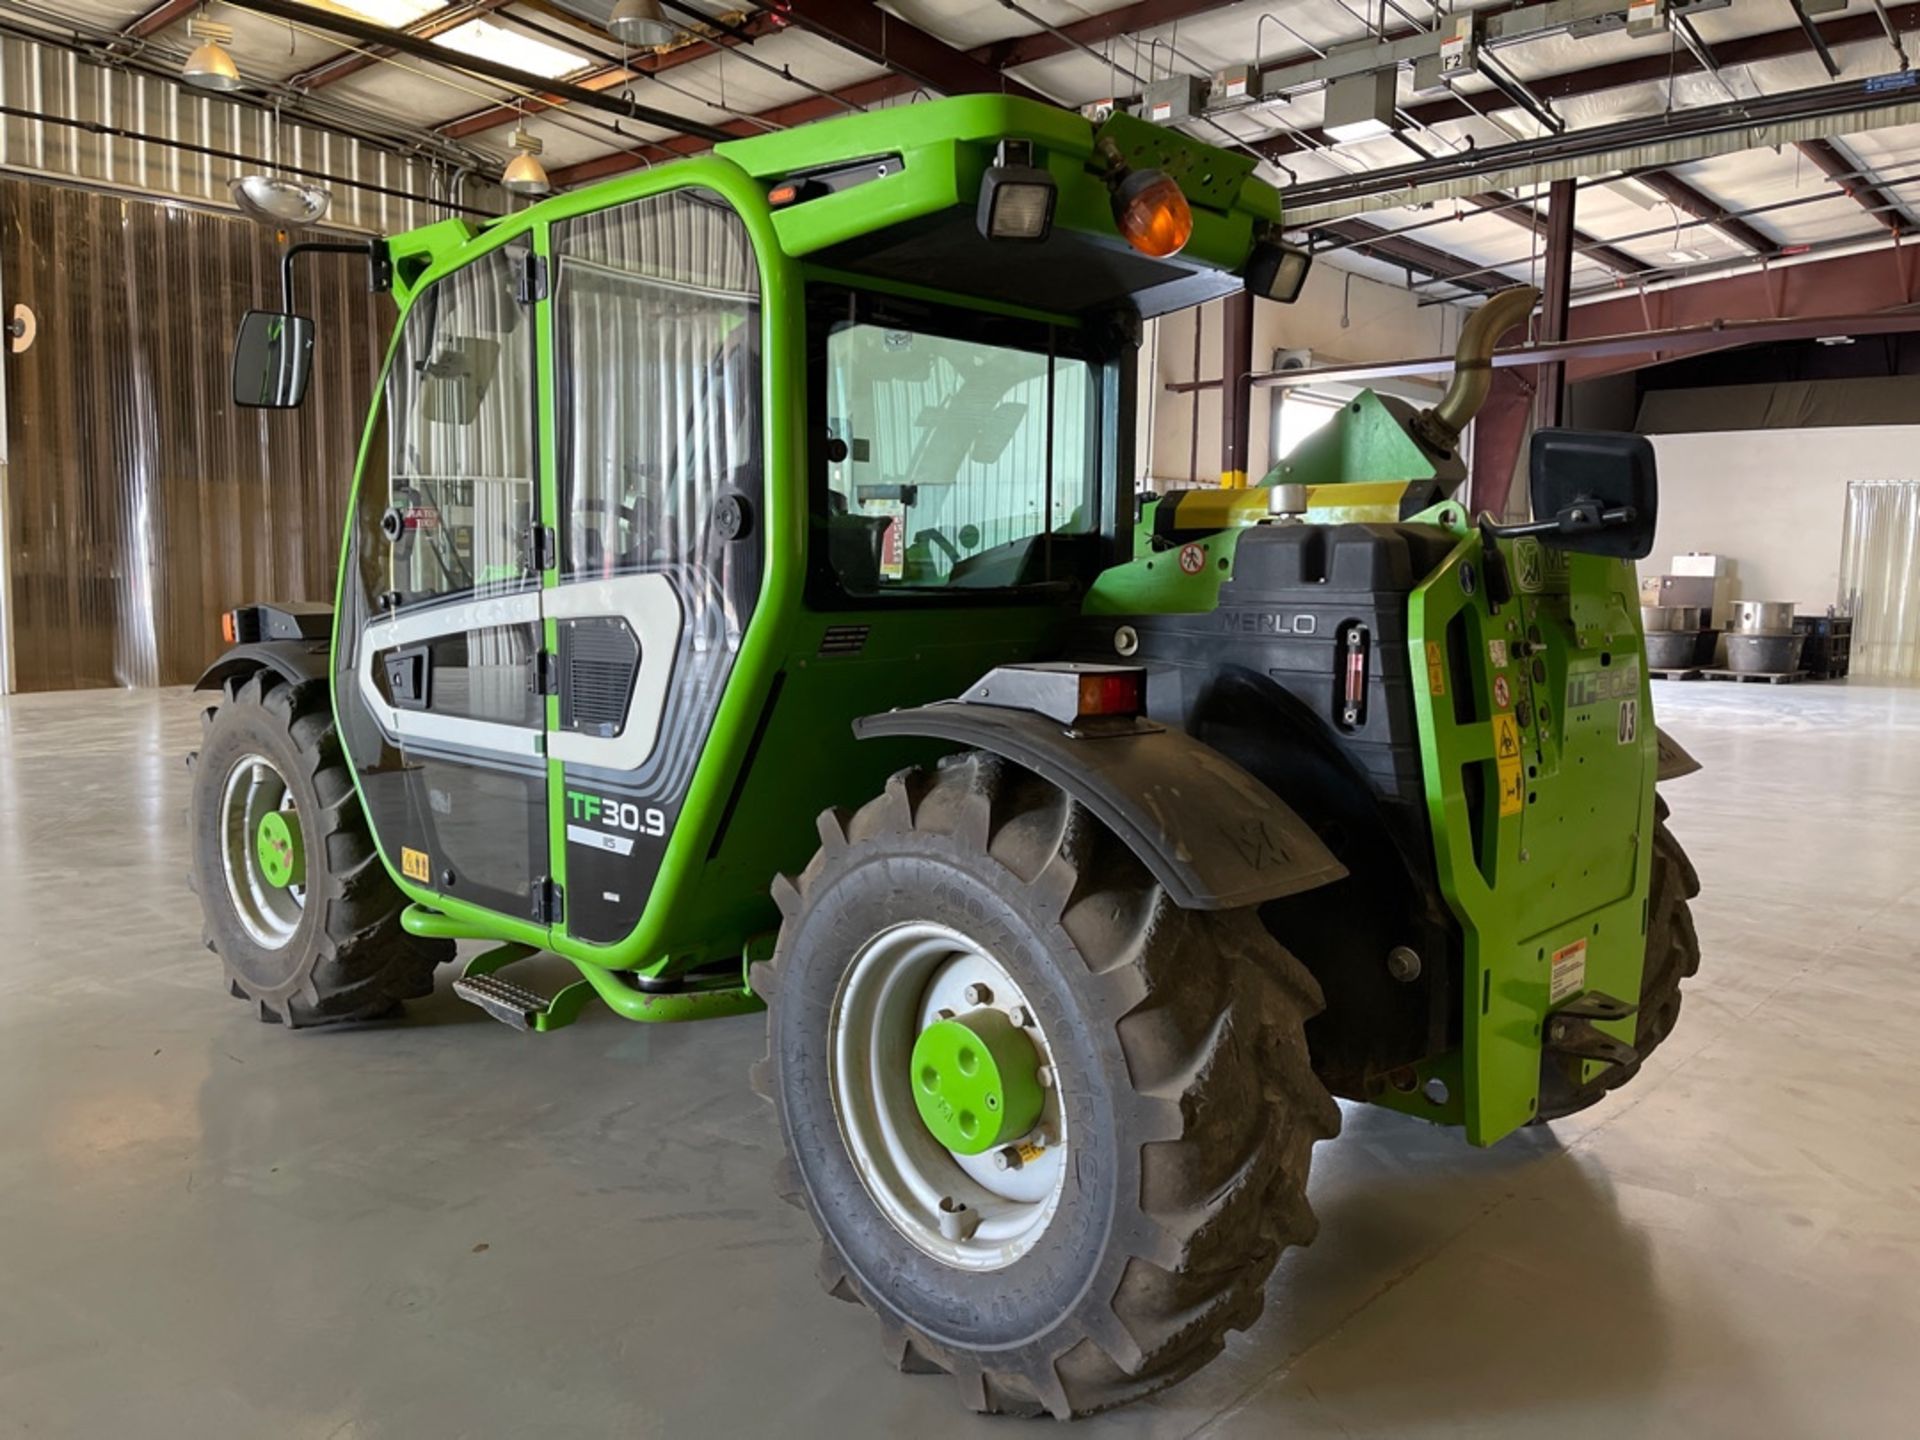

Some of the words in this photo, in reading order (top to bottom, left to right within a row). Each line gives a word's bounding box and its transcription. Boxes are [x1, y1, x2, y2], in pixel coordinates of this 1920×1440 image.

[1445, 54, 1461, 70] F2
[1224, 612, 1318, 635] MERLO
[1619, 701, 1635, 743] 03
[567, 791, 665, 836] TF30.9
